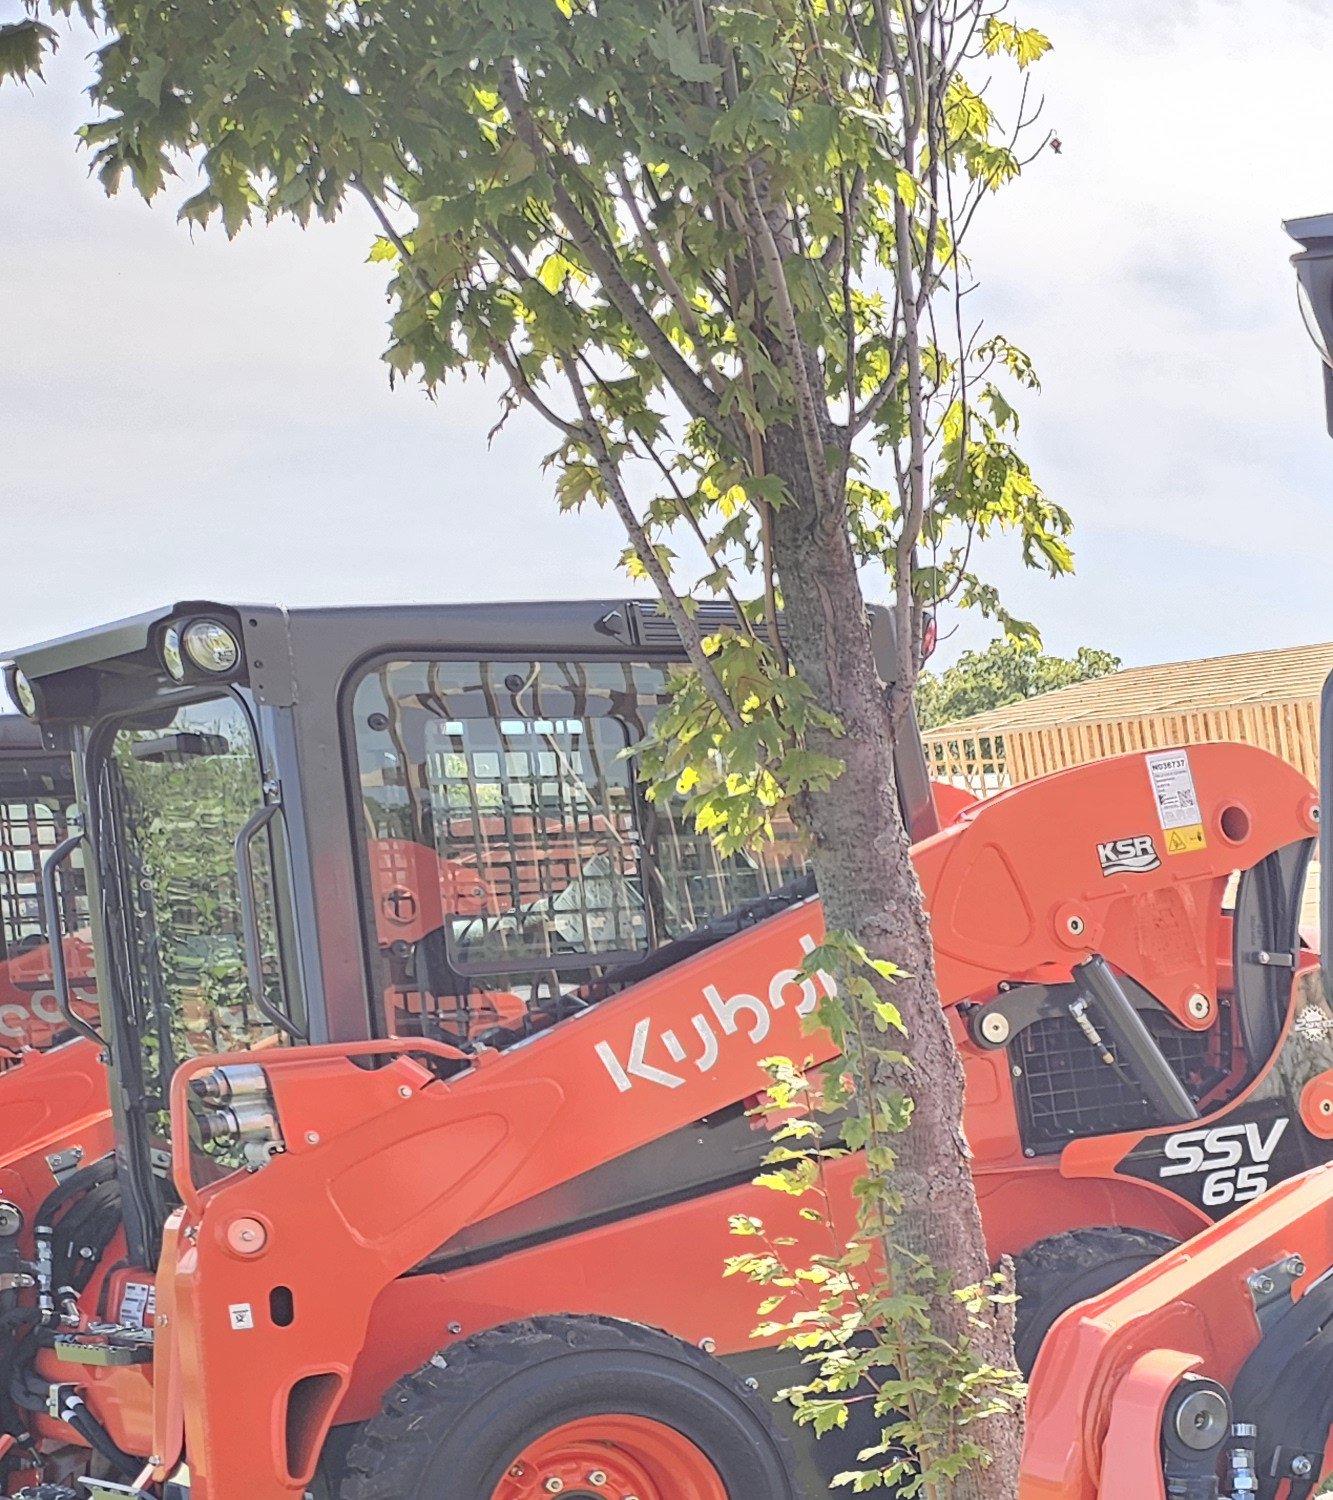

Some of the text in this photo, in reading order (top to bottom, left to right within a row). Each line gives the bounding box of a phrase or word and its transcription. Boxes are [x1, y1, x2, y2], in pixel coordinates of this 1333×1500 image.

[1097, 835, 1155, 864] KSR
[1159, 1117, 1288, 1178] SSV
[1203, 1163, 1269, 1206] 65
